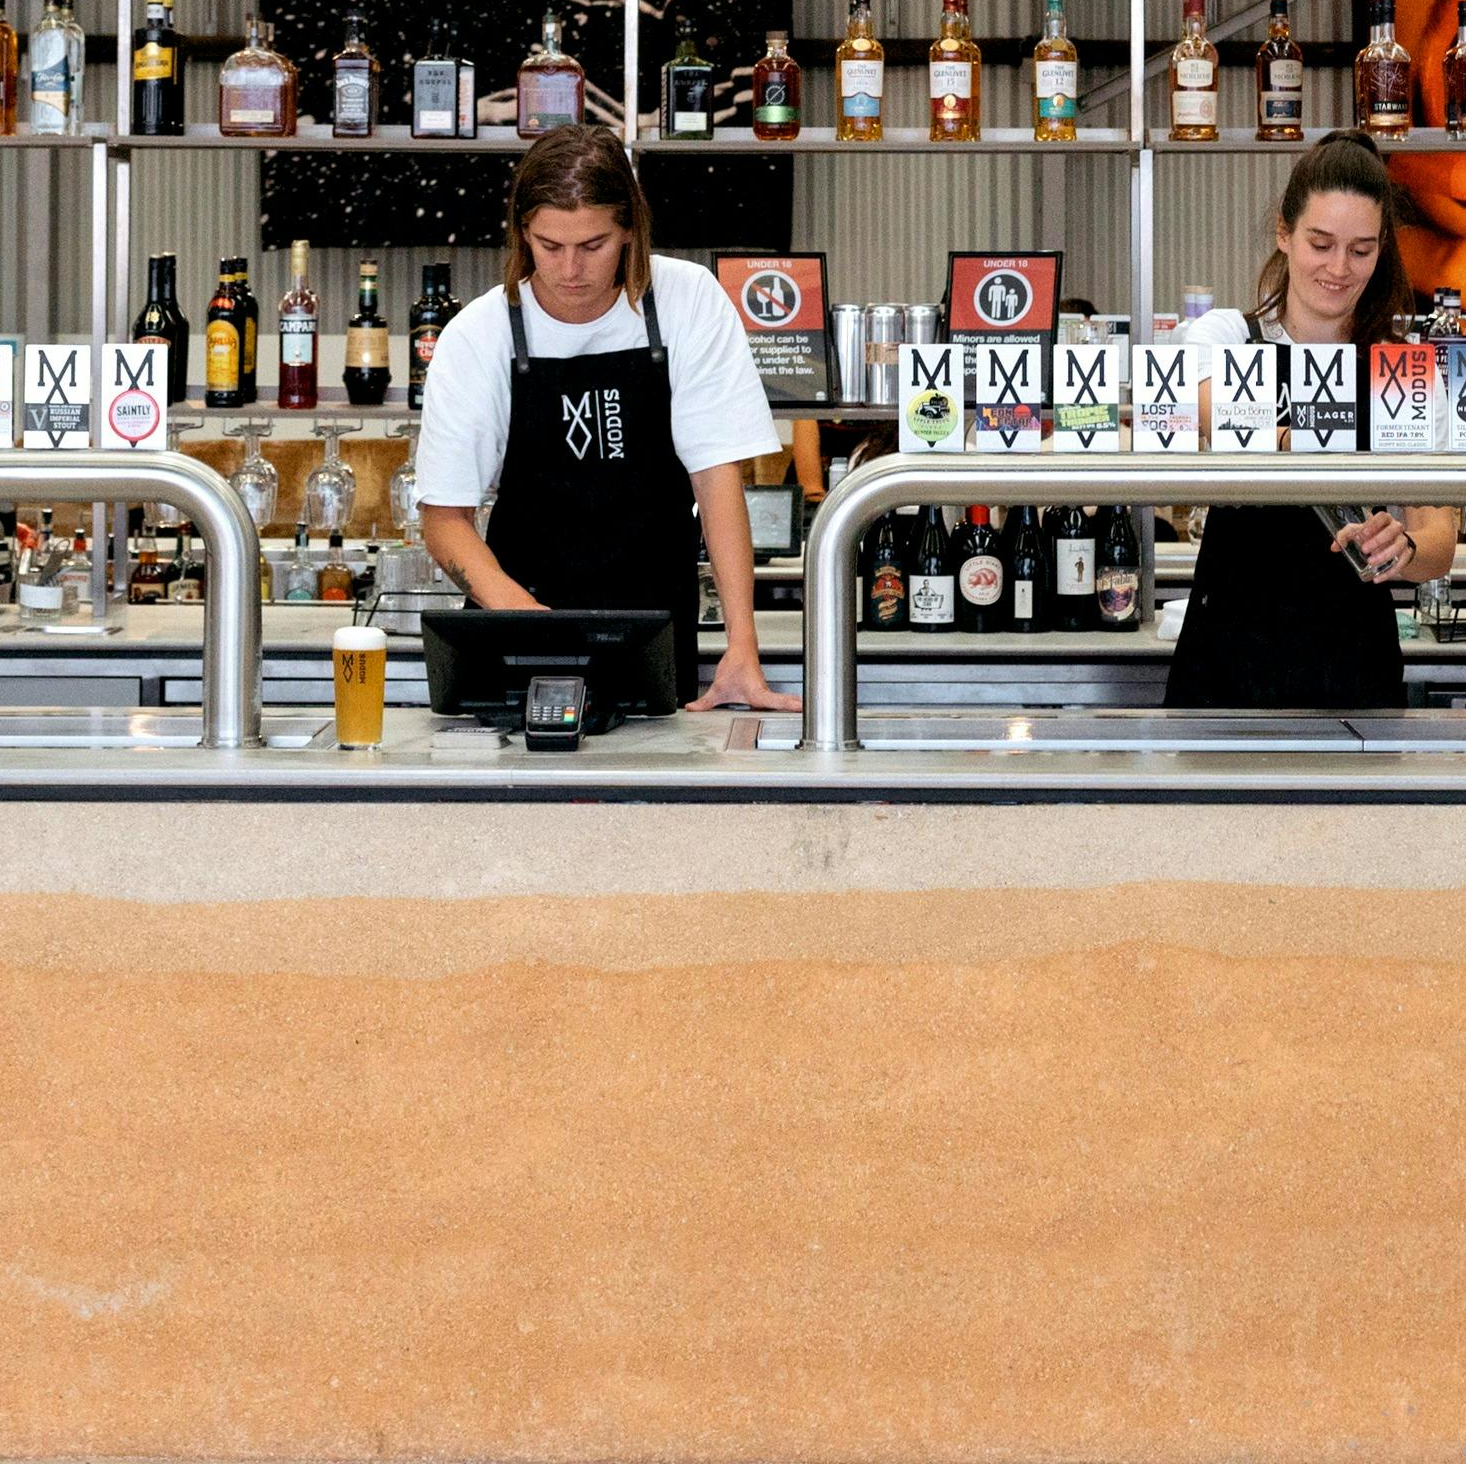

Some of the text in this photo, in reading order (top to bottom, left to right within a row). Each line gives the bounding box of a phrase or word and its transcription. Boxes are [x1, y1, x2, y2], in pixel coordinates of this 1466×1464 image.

[983, 259, 1028, 268] UNDER 18
[796, 335, 808, 343] be
[953, 335, 984, 343] Minors
[1005, 335, 1040, 343] allowed
[760, 346, 799, 355] supplied
[762, 356, 789, 364] under
[1412, 351, 1427, 420] MODUS
[116, 405, 151, 416] SAINTLY
[1141, 404, 1176, 415] LOST
[1216, 406, 1232, 416] You
[1234, 406, 1247, 415] Da
[1316, 411, 1354, 419] LAGER
[603, 388, 624, 459] MODUS
